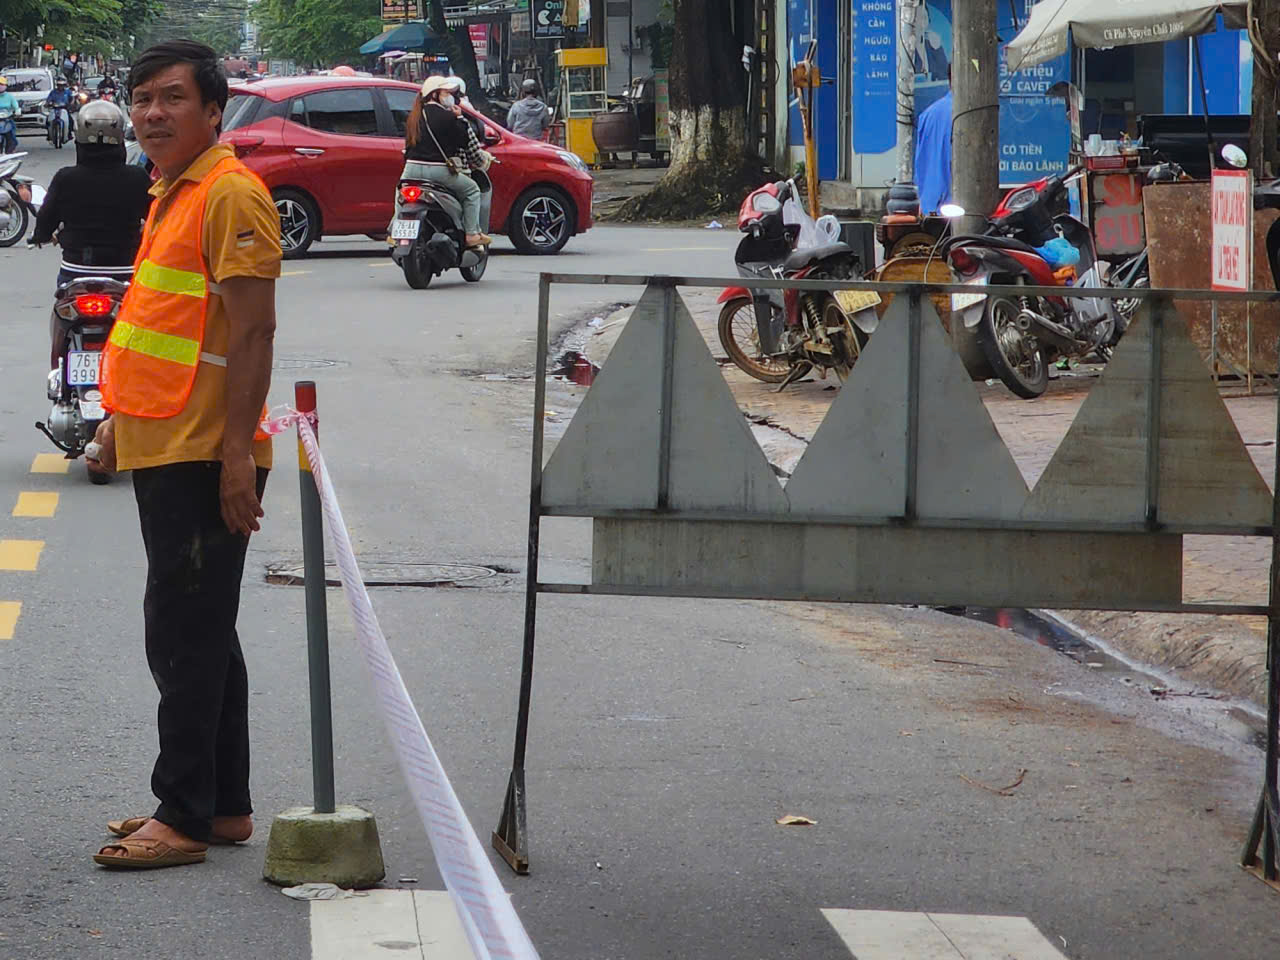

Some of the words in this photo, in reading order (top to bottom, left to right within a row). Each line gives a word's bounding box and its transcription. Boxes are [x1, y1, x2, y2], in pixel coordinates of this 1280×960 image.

[862, 1, 892, 12] KHÔNG
[1019, 141, 1043, 155] TIỀN
[1012, 158, 1034, 171] BẢO
[1035, 158, 1064, 171] LÃNH
